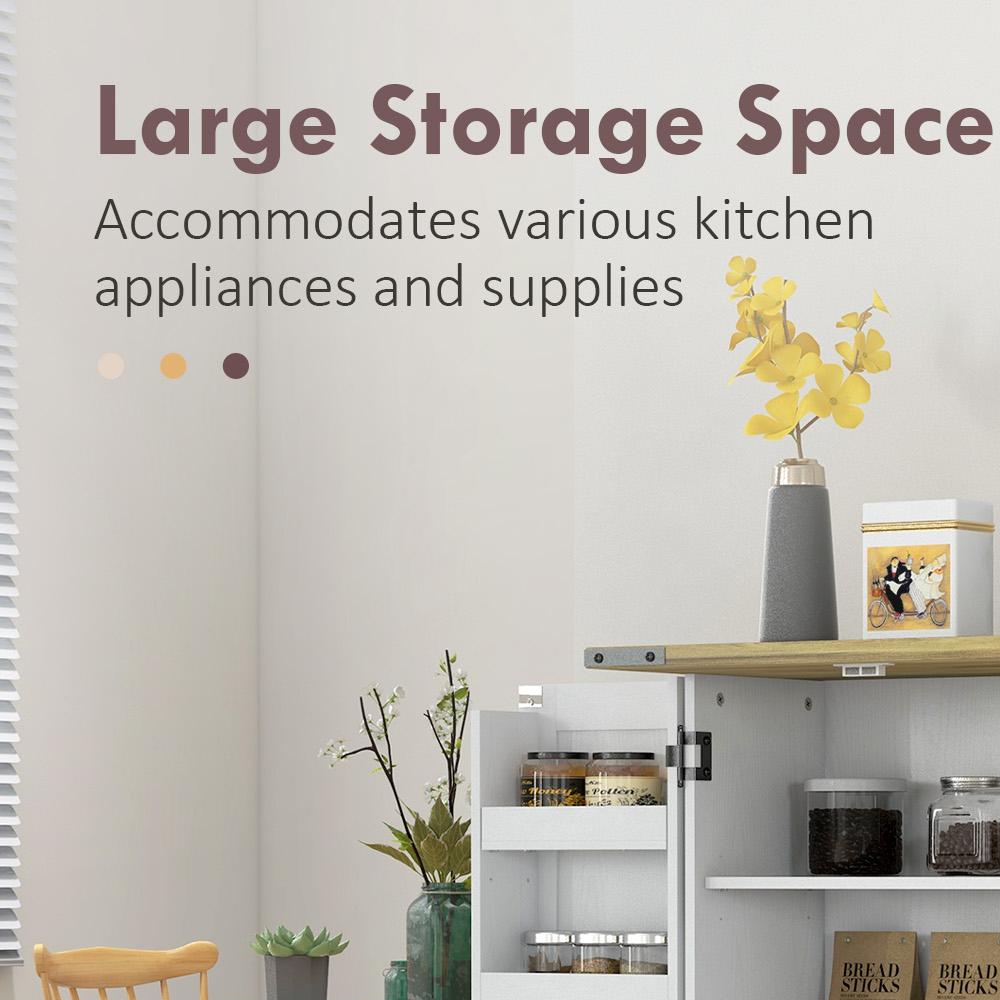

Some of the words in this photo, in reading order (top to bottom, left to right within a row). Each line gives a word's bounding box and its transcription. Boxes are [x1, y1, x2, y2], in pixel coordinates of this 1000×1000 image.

[842, 962, 900, 977] BREAD
[939, 964, 998, 979] BREAD
[841, 977, 900, 993] STICKS
[937, 979, 999, 995] STICKS
